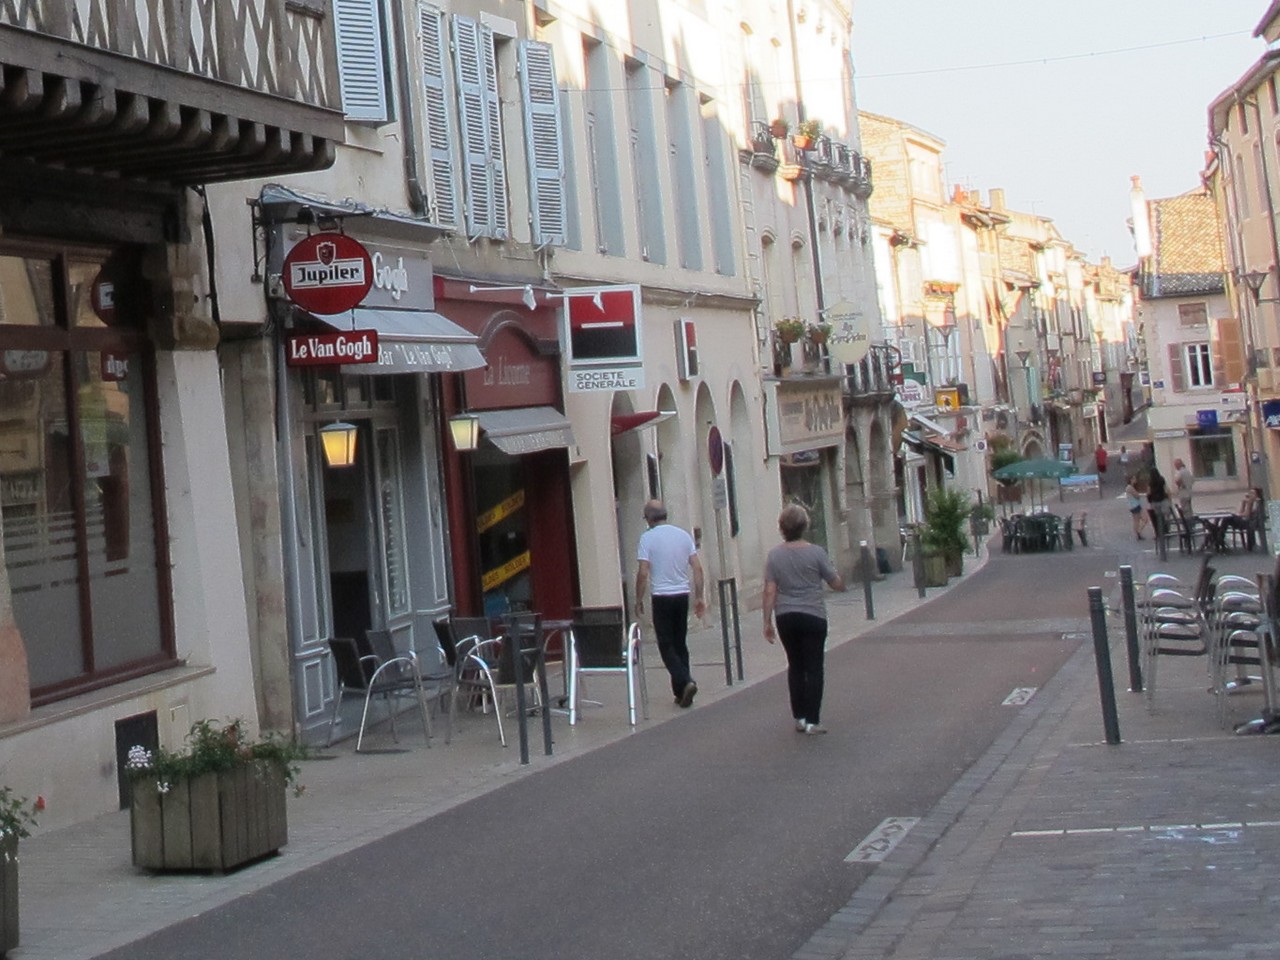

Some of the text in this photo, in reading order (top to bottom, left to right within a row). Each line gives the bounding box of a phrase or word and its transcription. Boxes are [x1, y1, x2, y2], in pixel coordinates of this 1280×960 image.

[297, 264, 359, 285] Jupiler
[372, 251, 408, 300] Gogh
[291, 335, 372, 360] Le Van Gogh
[576, 371, 624, 381] SOCIETE
[576, 379, 636, 389] GENERALE
